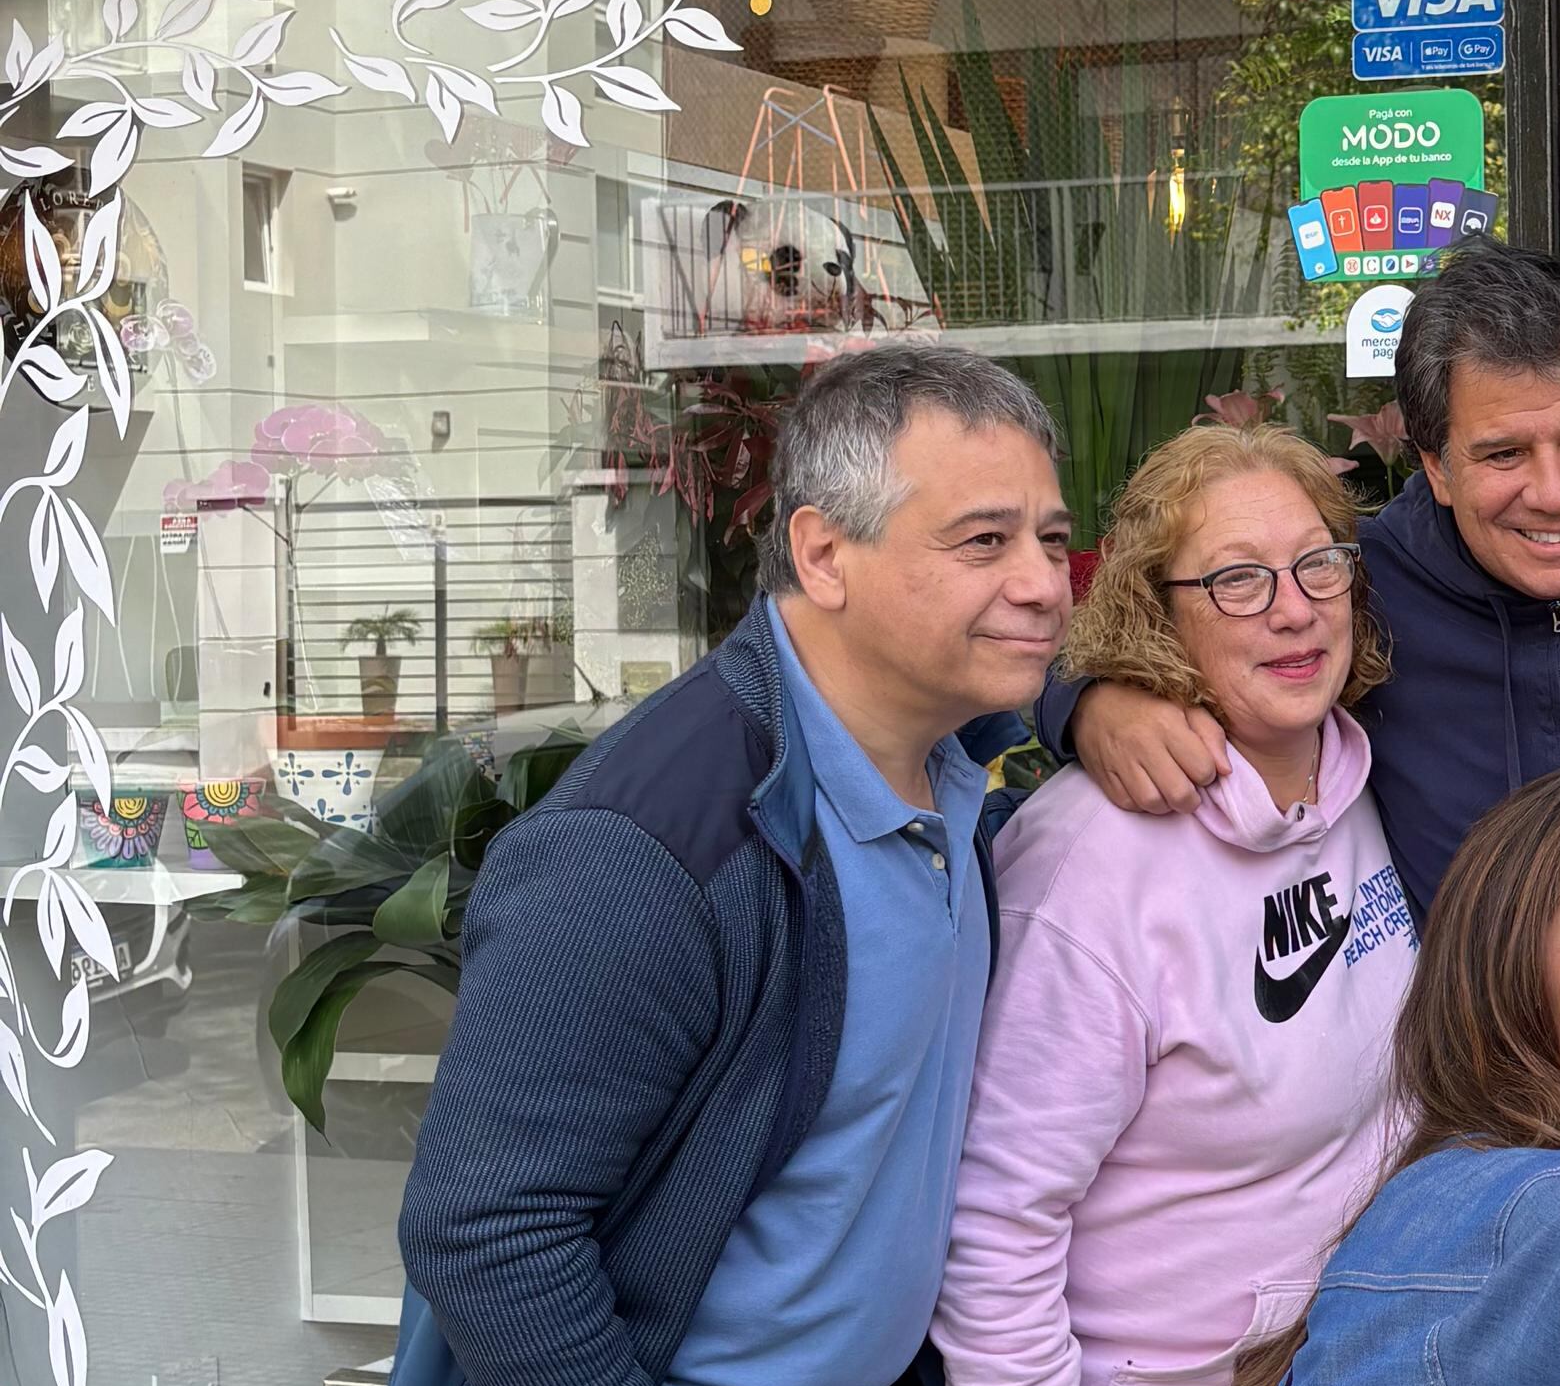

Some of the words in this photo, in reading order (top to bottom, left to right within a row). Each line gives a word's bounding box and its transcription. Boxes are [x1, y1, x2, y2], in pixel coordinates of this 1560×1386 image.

[1362, 45, 1403, 62] VISA
[1432, 46, 1449, 57] Pay
[1474, 44, 1491, 55] Pay
[1369, 109, 1394, 119] Pagá
[1395, 109, 1413, 118] con
[1342, 121, 1441, 151] MODO
[1332, 156, 1361, 167] desde
[1362, 156, 1371, 165] la
[1372, 154, 1393, 167] App
[1394, 154, 1408, 164] de
[1409, 153, 1420, 163] tu
[1421, 151, 1452, 162] banco
[1434, 209, 1452, 221] NX
[1361, 338, 1399, 347] merca
[1372, 349, 1396, 359] pag
[1263, 870, 1344, 962] NIKE
[1352, 884, 1406, 933] NATIONA
[1383, 908, 1410, 936] CRE
